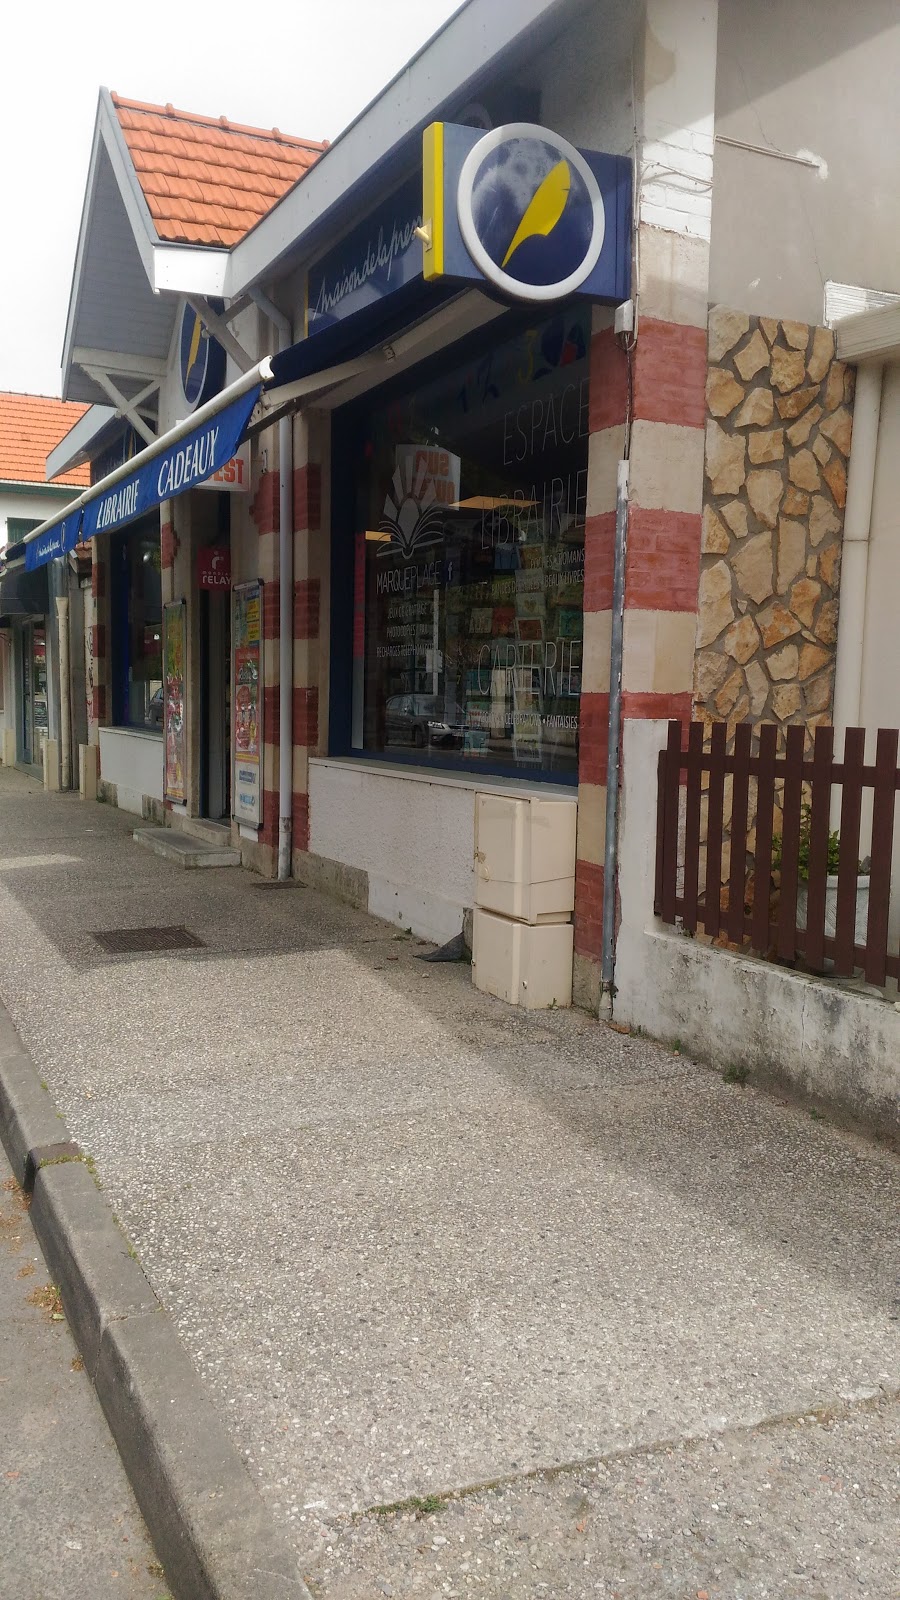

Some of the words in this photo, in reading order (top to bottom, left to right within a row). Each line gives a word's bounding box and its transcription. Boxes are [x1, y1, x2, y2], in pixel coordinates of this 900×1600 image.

[503, 377, 590, 466] ESPACE
[157, 426, 219, 497] CADEAUX
[207, 458, 245, 484] EST
[96, 479, 140, 529] LIBRAIRIE
[481, 468, 588, 550] LIBRAIRIE
[478, 639, 582, 696] CARTERIE
[546, 714, 578, 730] FANTAISIES
